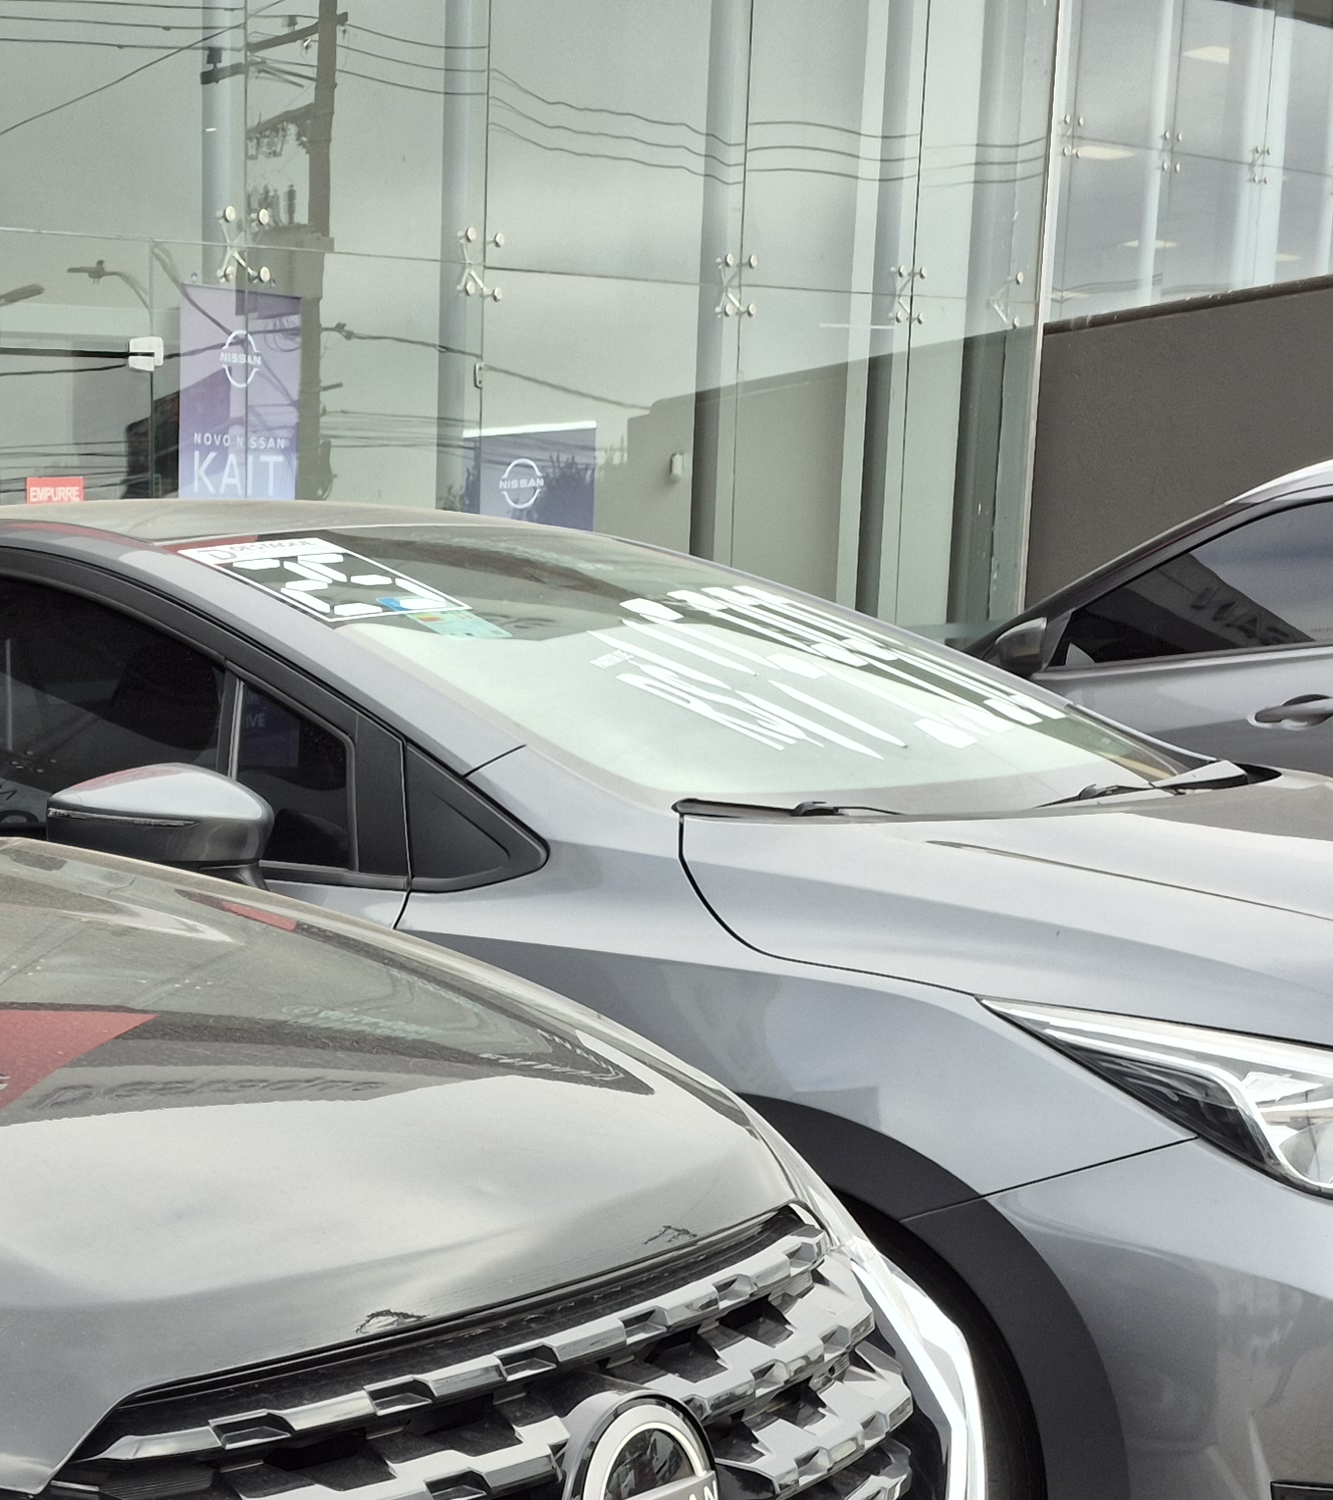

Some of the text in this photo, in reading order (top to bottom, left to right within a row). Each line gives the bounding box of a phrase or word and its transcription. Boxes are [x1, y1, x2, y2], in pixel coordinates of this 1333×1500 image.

[220, 351, 261, 365] NISSAN
[194, 432, 285, 449] NOVO NSSAN
[194, 451, 285, 497] KAIT
[499, 478, 544, 489] NISSAN
[30, 486, 80, 502] EMPURRE
